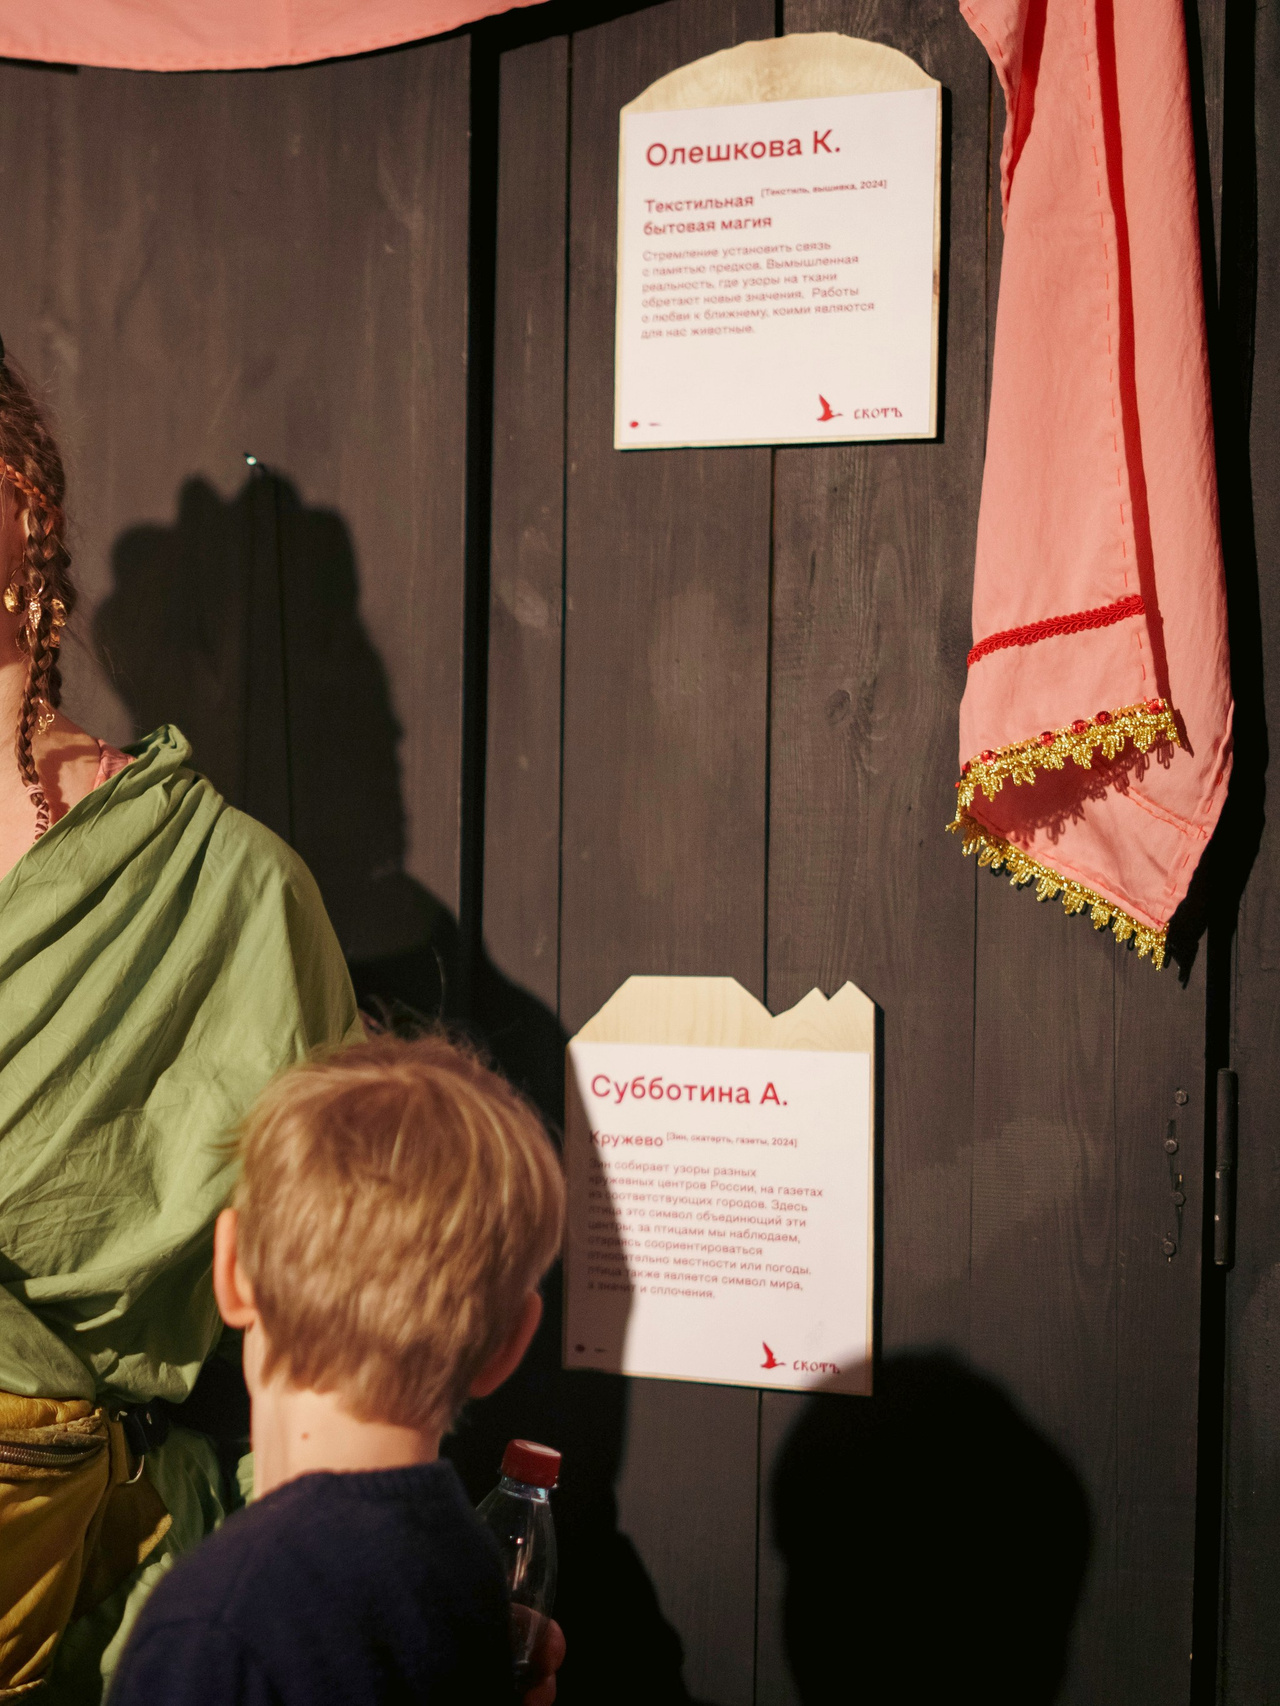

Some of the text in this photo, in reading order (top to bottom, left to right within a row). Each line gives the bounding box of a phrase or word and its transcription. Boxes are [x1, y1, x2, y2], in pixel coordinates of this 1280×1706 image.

[646, 130, 840, 166] Олешкова К.
[644, 195, 754, 213] Текстильная
[859, 179, 887, 189] 2024]
[643, 216, 771, 235] бытовая магия
[642, 241, 831, 262] Стремление установить связь
[652, 264, 706, 276] памятью
[765, 255, 858, 269] Вымышленная
[718, 278, 739, 288] где
[742, 276, 780, 289] узоры
[783, 275, 798, 283] на
[801, 272, 837, 282] ткани
[641, 295, 700, 308] обретают
[703, 293, 742, 304] новые
[811, 285, 859, 298] Работы
[651, 310, 691, 322] любви
[772, 306, 811, 316] коими
[813, 301, 874, 313] являются
[640, 329, 663, 339] для
[665, 327, 687, 337] нас
[591, 1075, 787, 1106] Субботина А.
[588, 1129, 665, 1151] Кружево
[771, 1137, 797, 1148] 2024]
[614, 1159, 669, 1173] собирает
[673, 1164, 709, 1176] узоры
[713, 1167, 756, 1177] разных
[657, 1179, 707, 1191] центров
[710, 1179, 756, 1194] России,
[760, 1185, 774, 1194] на
[777, 1186, 822, 1197] газетах
[715, 1197, 766, 1209] городов.
[771, 1198, 808, 1212] Здесь
[626, 1207, 645, 1217] это
[648, 1209, 692, 1219] символ
[785, 1218, 806, 1227] эти
[638, 1223, 650, 1232] за
[653, 1224, 704, 1235] птицами
[707, 1228, 725, 1237] мы
[729, 1228, 800, 1244] наблюдаем,
[672, 1257, 736, 1269] местности
[739, 1262, 761, 1270] или
[765, 1263, 811, 1275] погоды.
[639, 1285, 647, 1293] и
[663, 1271, 718, 1283] является
[721, 1275, 765, 1286] символ
[769, 1279, 803, 1291] мира,
